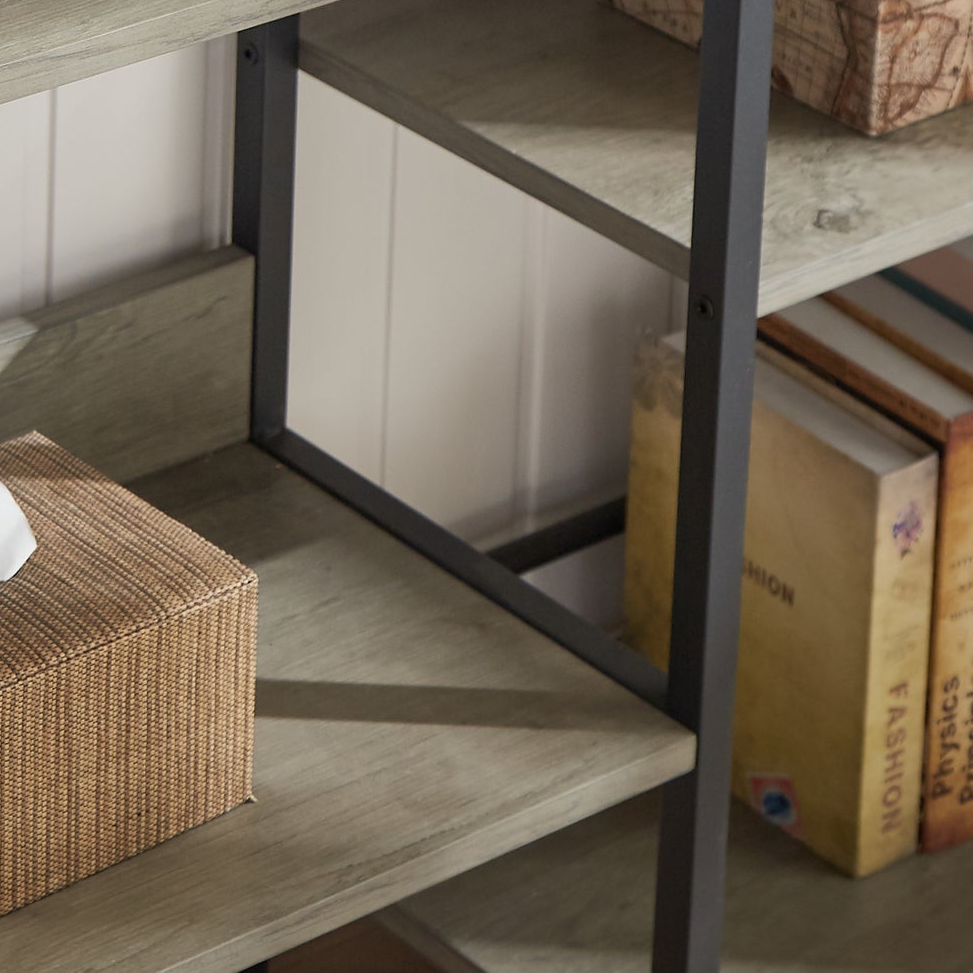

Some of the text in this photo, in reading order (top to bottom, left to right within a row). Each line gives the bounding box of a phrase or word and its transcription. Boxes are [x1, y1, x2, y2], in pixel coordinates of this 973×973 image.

[742, 558, 795, 606] HION
[882, 681, 909, 834] FASHION
[930, 675, 960, 801] Physics
